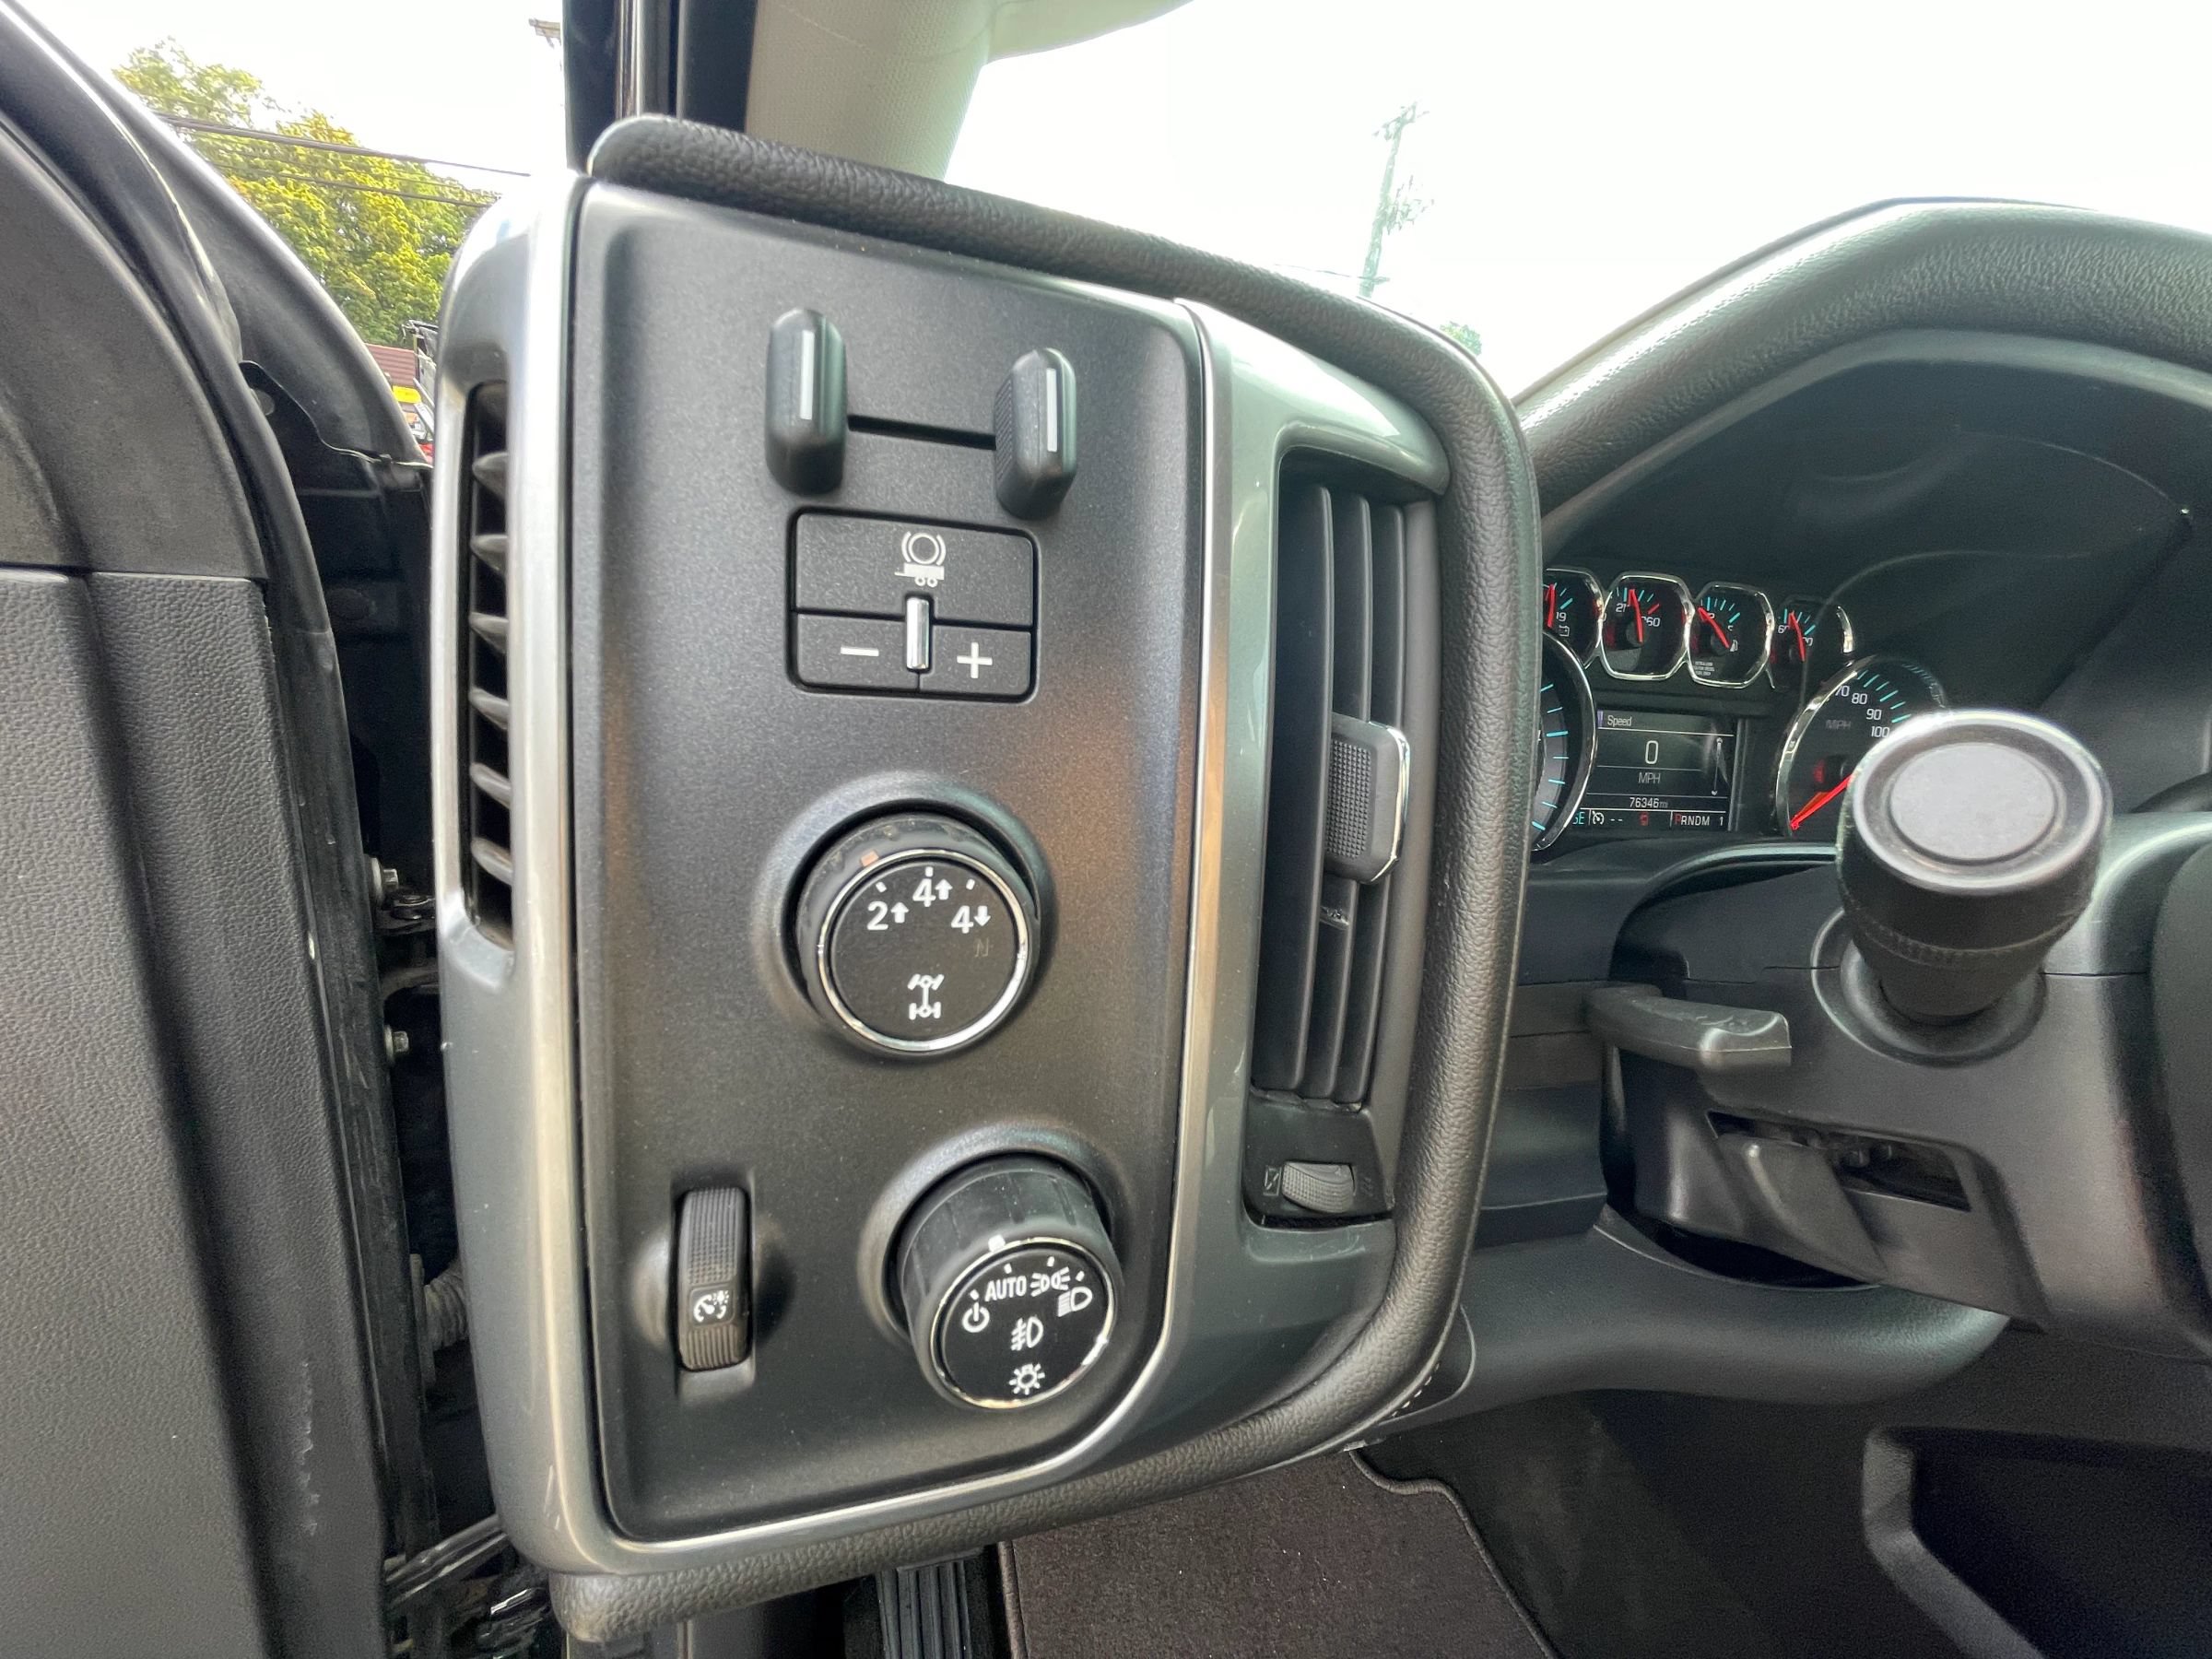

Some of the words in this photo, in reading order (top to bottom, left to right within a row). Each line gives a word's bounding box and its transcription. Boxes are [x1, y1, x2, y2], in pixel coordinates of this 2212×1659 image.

[1851, 692, 1868, 705] 80
[1606, 714, 1632, 726] Speed
[1866, 708, 1882, 721] 90
[1826, 719, 1852, 729] MPH
[1871, 725, 1889, 737] 100
[1644, 740, 1659, 765] 0
[1638, 772, 1661, 784] MPH
[912, 878, 935, 907] 4
[866, 901, 888, 930] 2
[951, 905, 974, 934] 4
[984, 1276, 1027, 1301] AUTO
